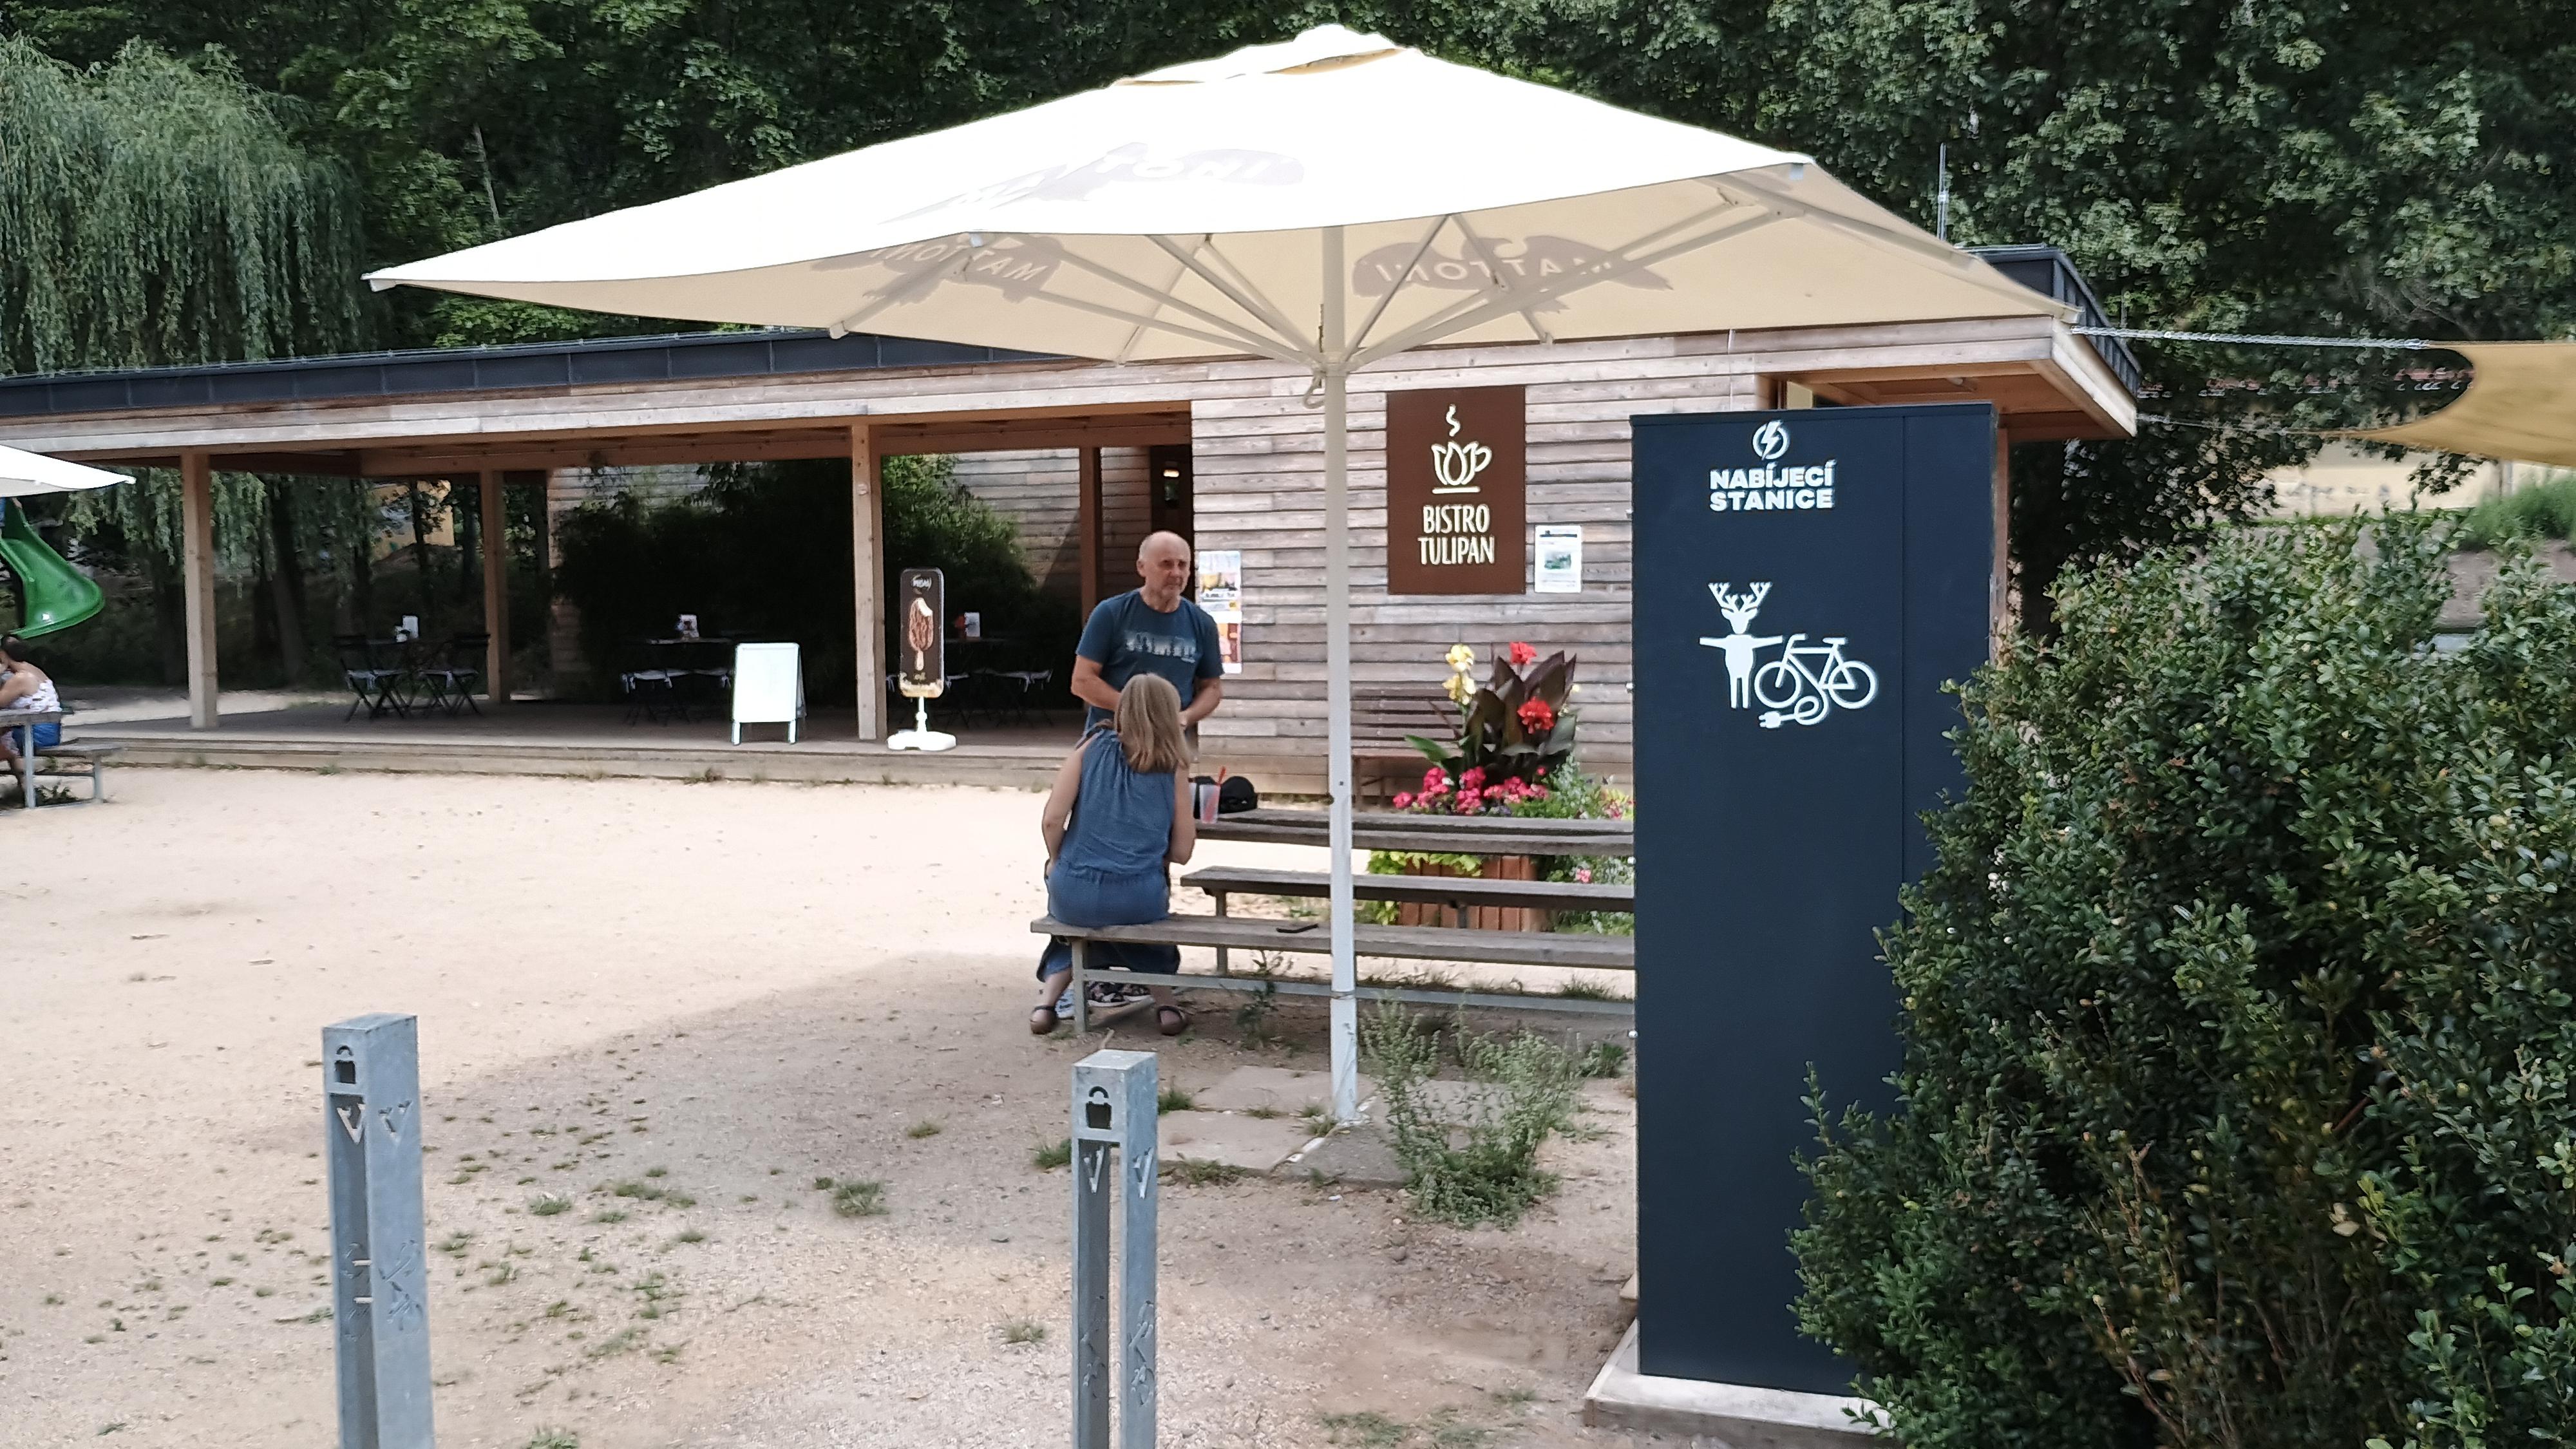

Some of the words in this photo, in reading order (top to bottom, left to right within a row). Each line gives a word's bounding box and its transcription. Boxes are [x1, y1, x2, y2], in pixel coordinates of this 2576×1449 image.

[1710, 459, 1837, 489] NABÍJECÍ
[1710, 488, 1835, 511] STANICE
[1423, 504, 1490, 533] BISTRO
[1417, 535, 1494, 565] TULIPAN
